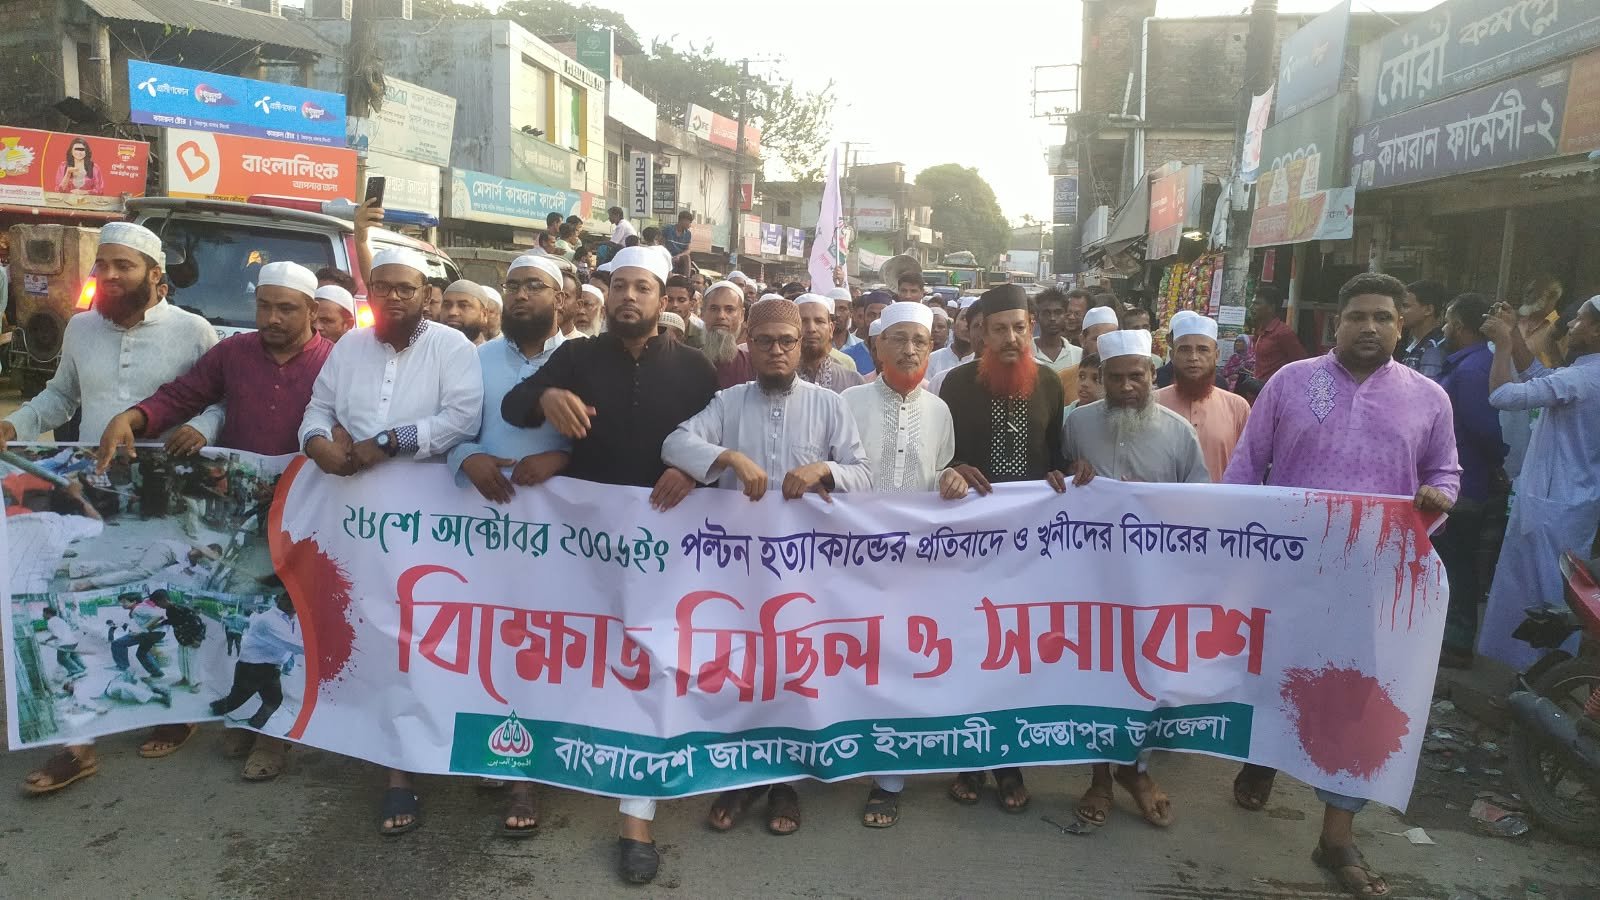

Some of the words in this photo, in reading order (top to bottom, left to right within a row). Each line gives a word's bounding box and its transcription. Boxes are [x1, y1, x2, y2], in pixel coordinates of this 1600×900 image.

[242, 154, 339, 180] বাংলালিংক
[1377, 125, 1440, 176] কামরান
[472, 178, 502, 200] মেসার্স
[504, 185, 538, 207] কামরান
[343, 505, 422, 553] ২৮শে
[430, 506, 551, 557] অক্টোবর
[680, 517, 753, 576] পল্টন
[916, 526, 1008, 564] প্রতিবাদে
[1013, 528, 1029, 552] ও
[1037, 510, 1114, 559] খুনীদের
[1120, 512, 1211, 555] বিচারের
[1217, 521, 1309, 562] দাবিতে
[395, 564, 652, 705] বিক্ষোভ
[674, 590, 885, 703] মিছিল
[907, 615, 953, 678] ও
[974, 596, 1272, 701] সমাবেশ
[552, 736, 697, 784] বাংলাদেশ
[704, 732, 864, 771] জামায়াতে
[1017, 716, 1117, 752] জৈন্তাপুর
[1124, 714, 1231, 747] উপজেলা
